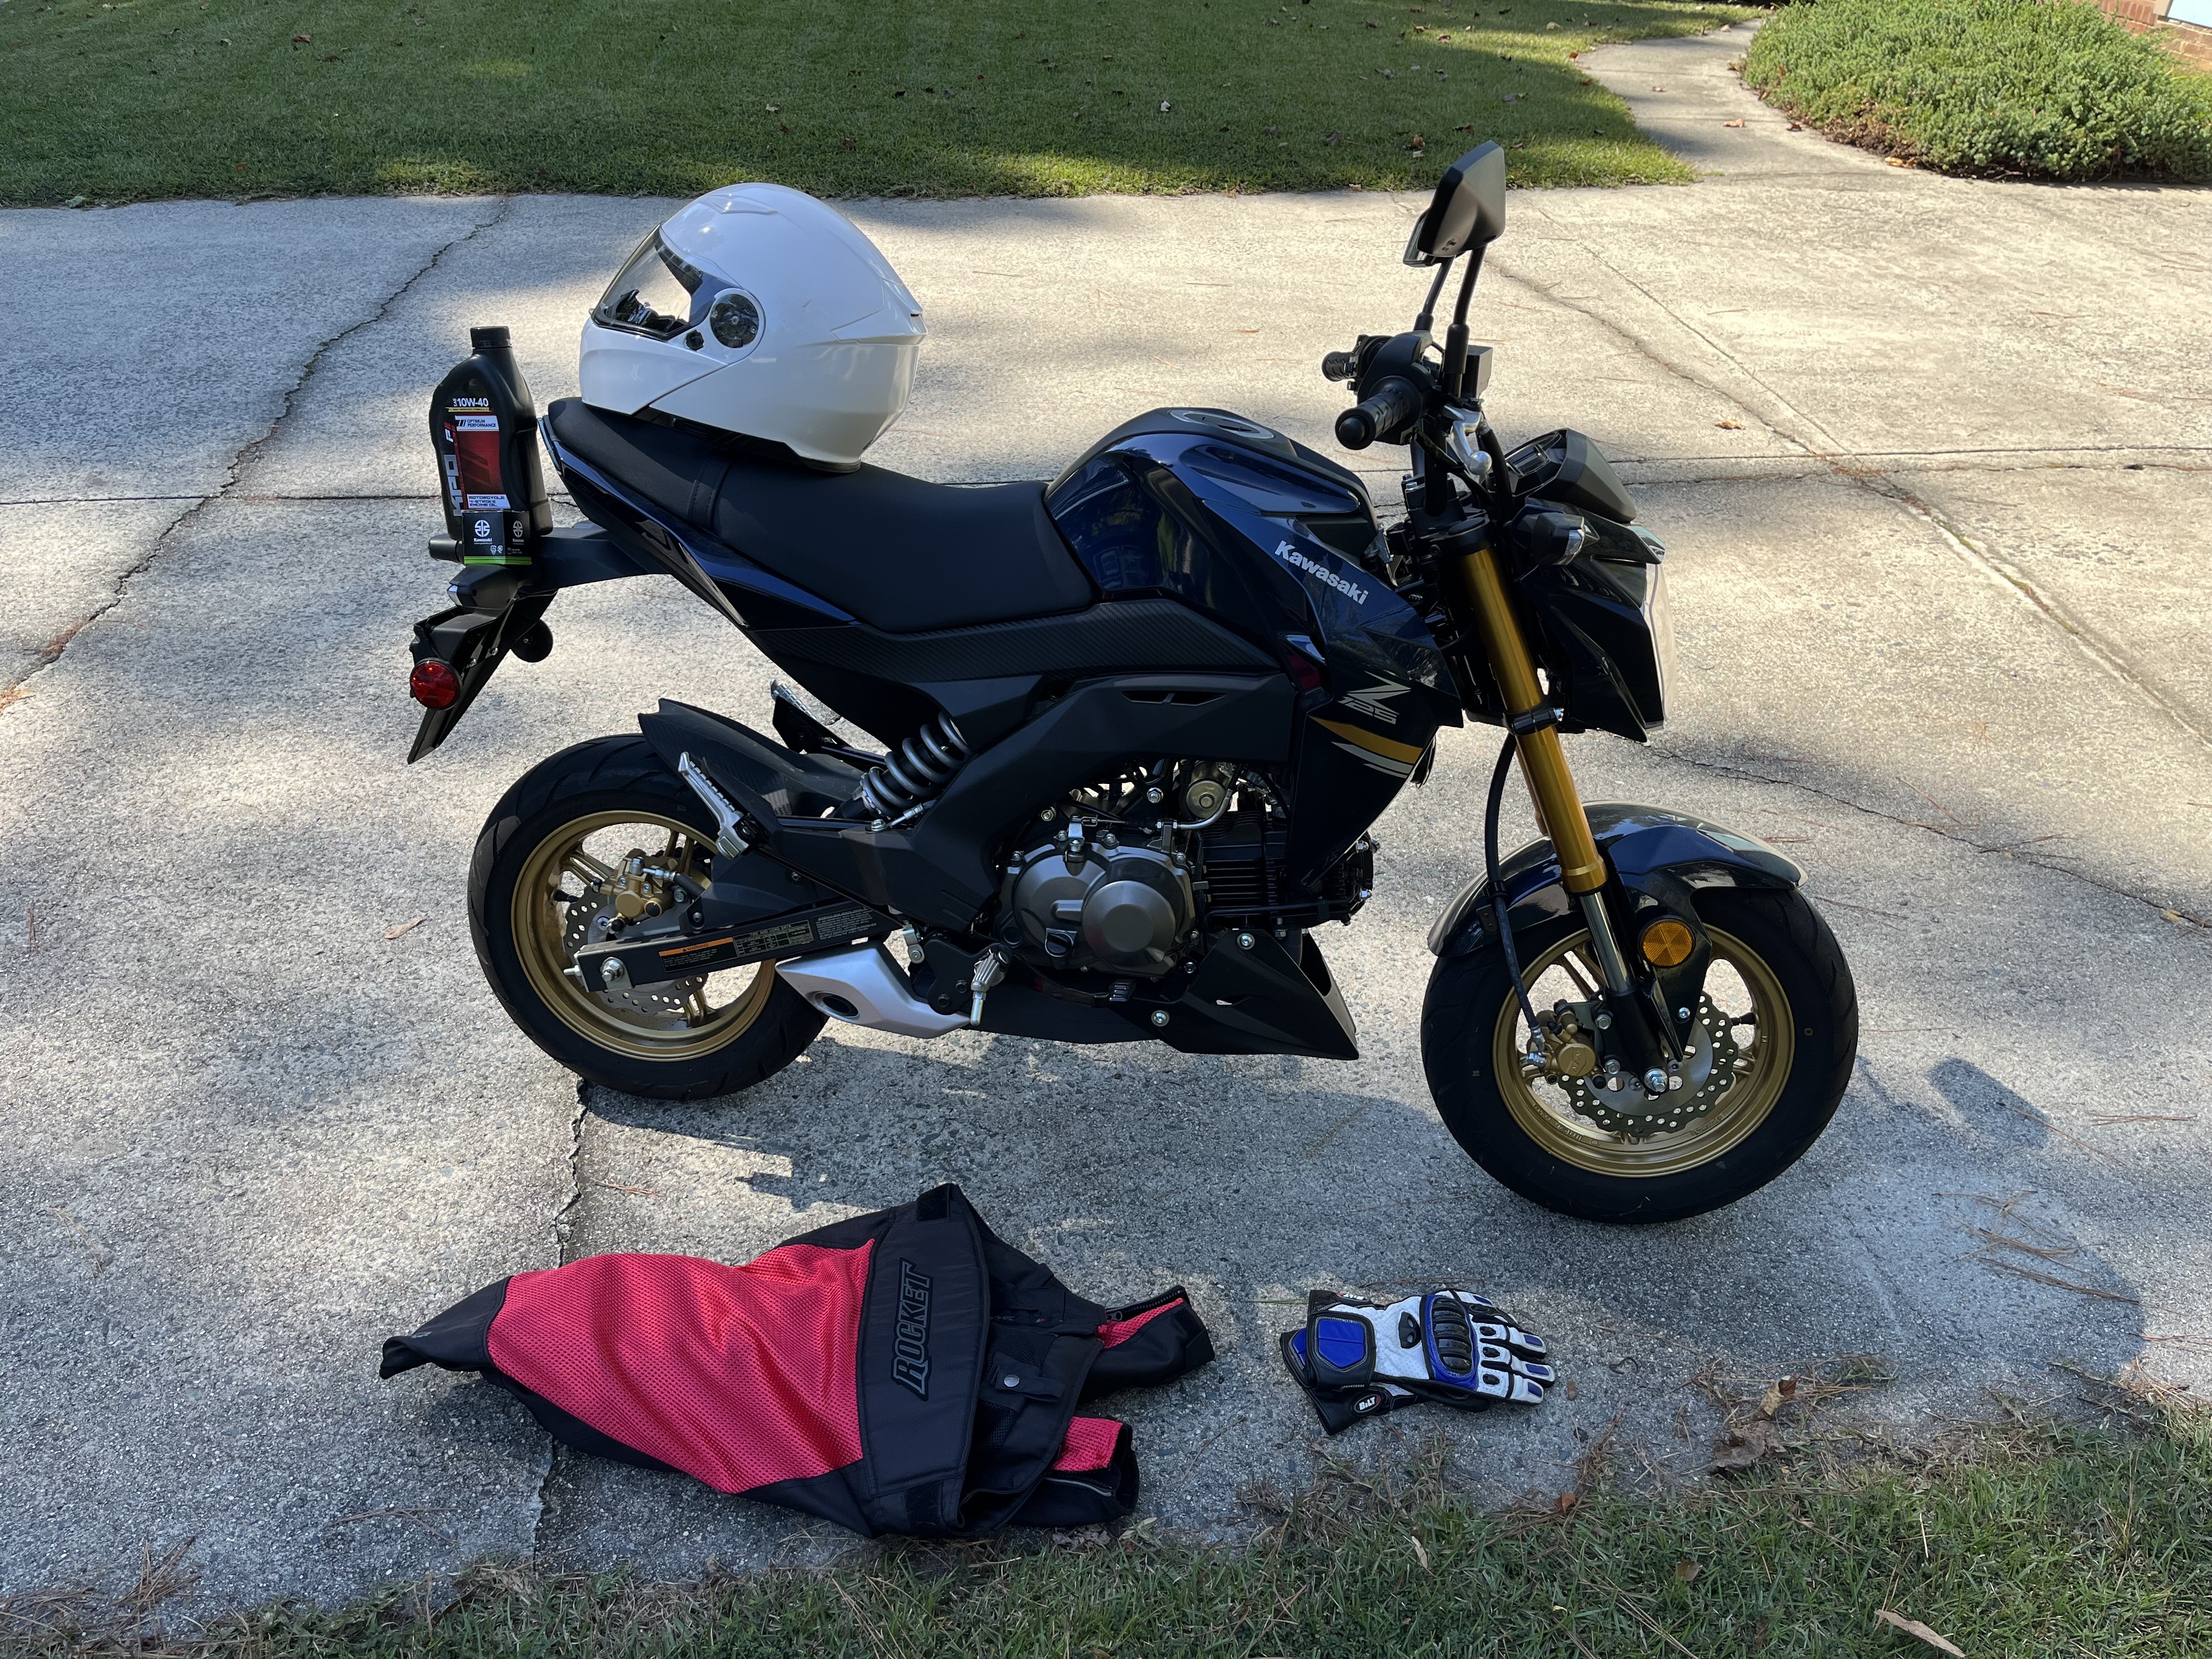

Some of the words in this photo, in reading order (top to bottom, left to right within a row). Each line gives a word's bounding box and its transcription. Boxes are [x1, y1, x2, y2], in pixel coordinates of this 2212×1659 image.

[457, 398, 489, 407] 10W-40
[444, 455, 464, 516] KPO
[1274, 540, 1369, 605] Kawasaki
[1338, 696, 1400, 725] 125
[687, 943, 709, 951] WARNING
[892, 1259, 932, 1398] ROCKET
[1359, 1396, 1375, 1410] BiLT
